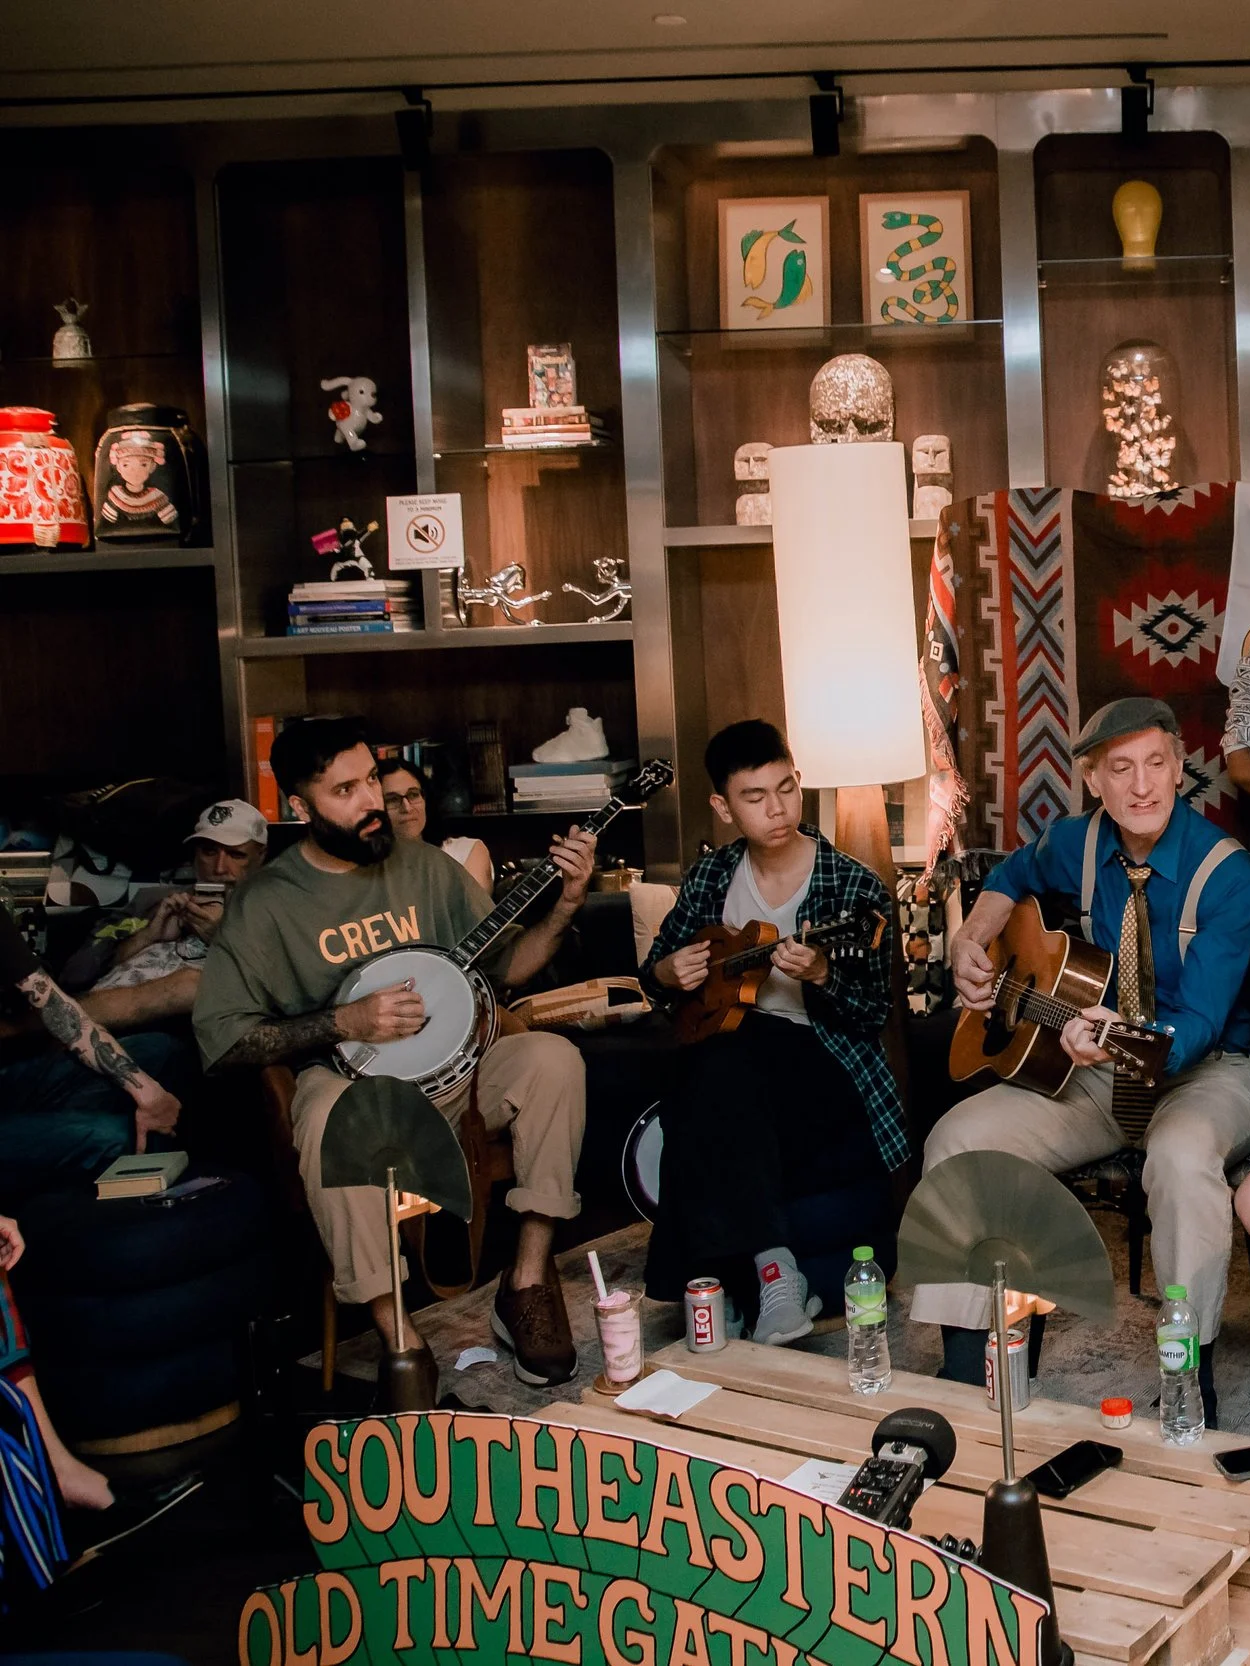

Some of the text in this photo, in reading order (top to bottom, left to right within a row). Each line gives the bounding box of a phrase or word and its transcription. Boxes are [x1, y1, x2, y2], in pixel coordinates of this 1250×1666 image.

[319, 905, 420, 964] CREW
[695, 1308, 712, 1343] LEO
[303, 1413, 1048, 1666] SOUTHEASTERN
[238, 1572, 363, 1666] OLD
[379, 1557, 588, 1665] TIME
